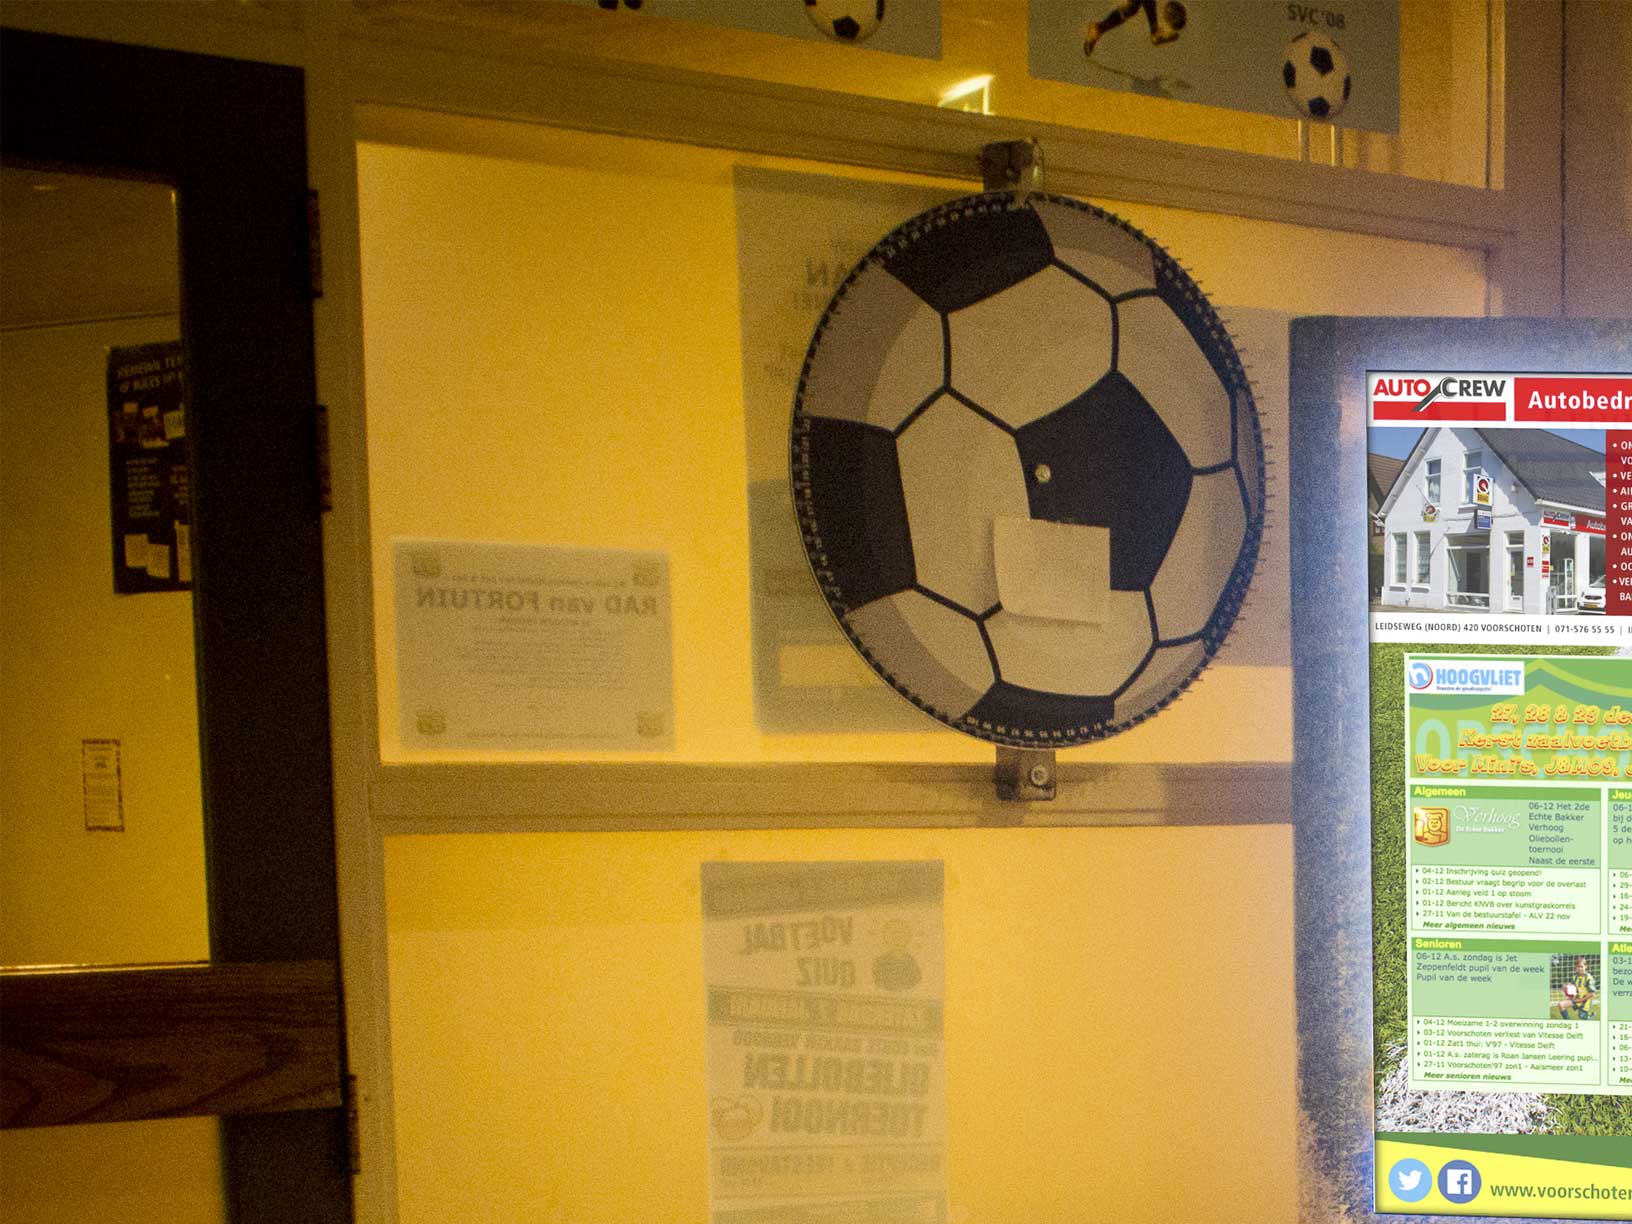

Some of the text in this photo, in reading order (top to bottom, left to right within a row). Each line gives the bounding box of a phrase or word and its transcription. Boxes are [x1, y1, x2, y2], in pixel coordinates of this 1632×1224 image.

[1373, 378, 1506, 397] AUTO CREW
[1375, 622, 1422, 631] LEIDSEWEG
[1424, 623, 1461, 632] (NOORD)
[1463, 624, 1479, 632] 420
[1481, 624, 1542, 633] VOORSCHOTEN
[1555, 625, 1589, 634] 071-576
[1591, 625, 1602, 634] 55
[1604, 626, 1615, 634] 55
[1458, 728, 1523, 749] Kerst
[1415, 753, 1467, 773] Voor
[1414, 786, 1466, 797] Algemeen
[1528, 802, 1590, 811] 06-12 Het 2de
[1528, 813, 1584, 822] Echte Bakker
[1528, 823, 1564, 833] Verhoog
[1613, 825, 1618, 833] 5
[1613, 837, 1624, 845] op
[1528, 845, 1564, 854] toernooi
[1528, 856, 1553, 865] Naast
[1555, 857, 1566, 865] de
[1415, 939, 1462, 949] Senioren
[1416, 953, 1518, 963] 06-12 A.s. zondag is Jet
[1416, 963, 1466, 973] Zeppenfeldt
[1469, 964, 1489, 973] pupil
[1509, 964, 1520, 973] de
[1522, 965, 1545, 973] week
[1416, 974, 1437, 983] Pupil
[1457, 974, 1468, 982] de
[1470, 974, 1493, 983] week
[1613, 978, 1625, 986] De
